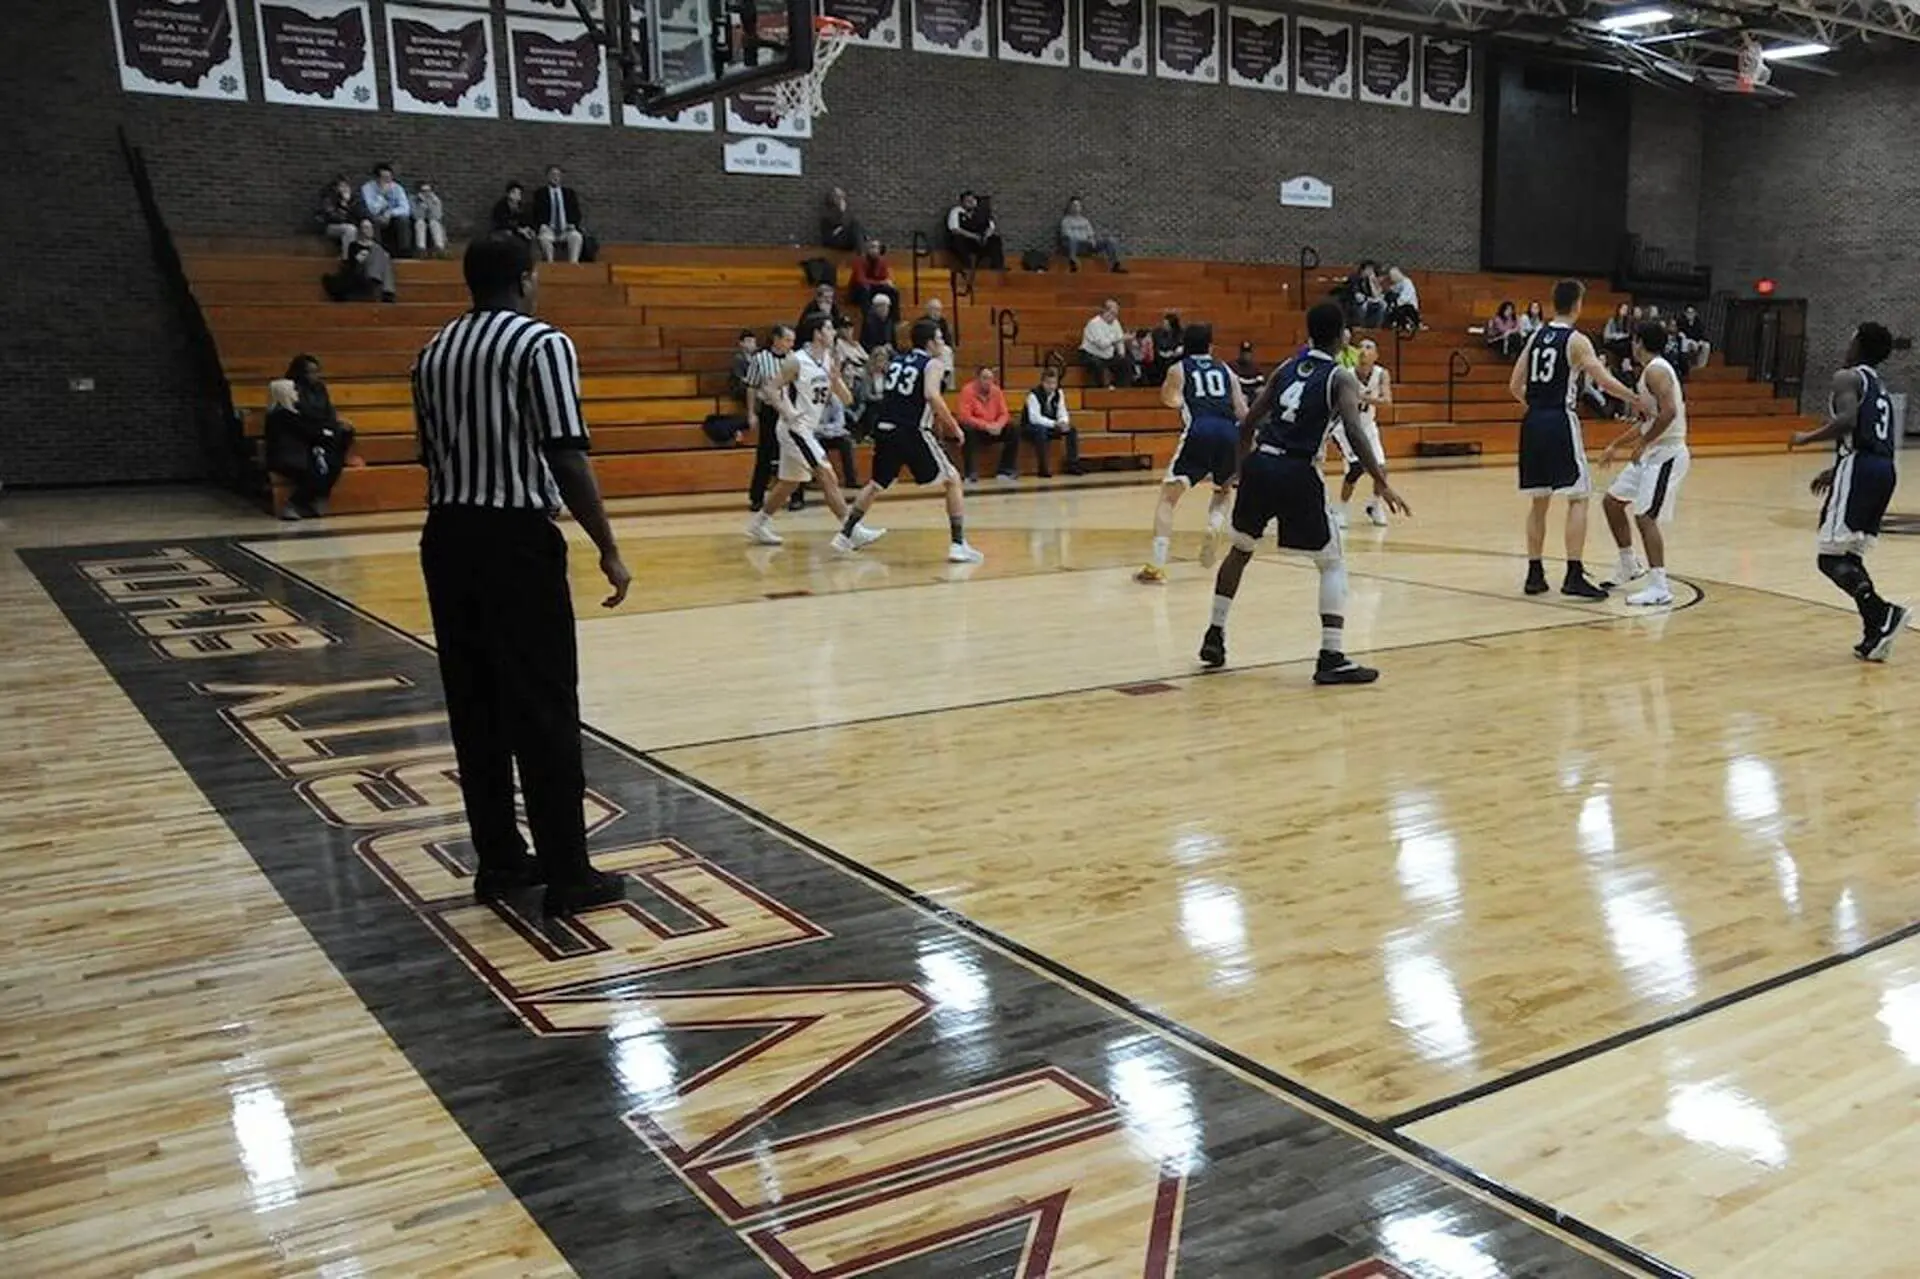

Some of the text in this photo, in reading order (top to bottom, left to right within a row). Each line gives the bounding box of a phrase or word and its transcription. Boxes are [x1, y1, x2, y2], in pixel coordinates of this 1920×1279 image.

[884, 361, 920, 397] 33
[1191, 368, 1226, 398] 10
[1530, 346, 1557, 384] 13
[1279, 380, 1308, 424] 4
[1874, 397, 1891, 441] 3
